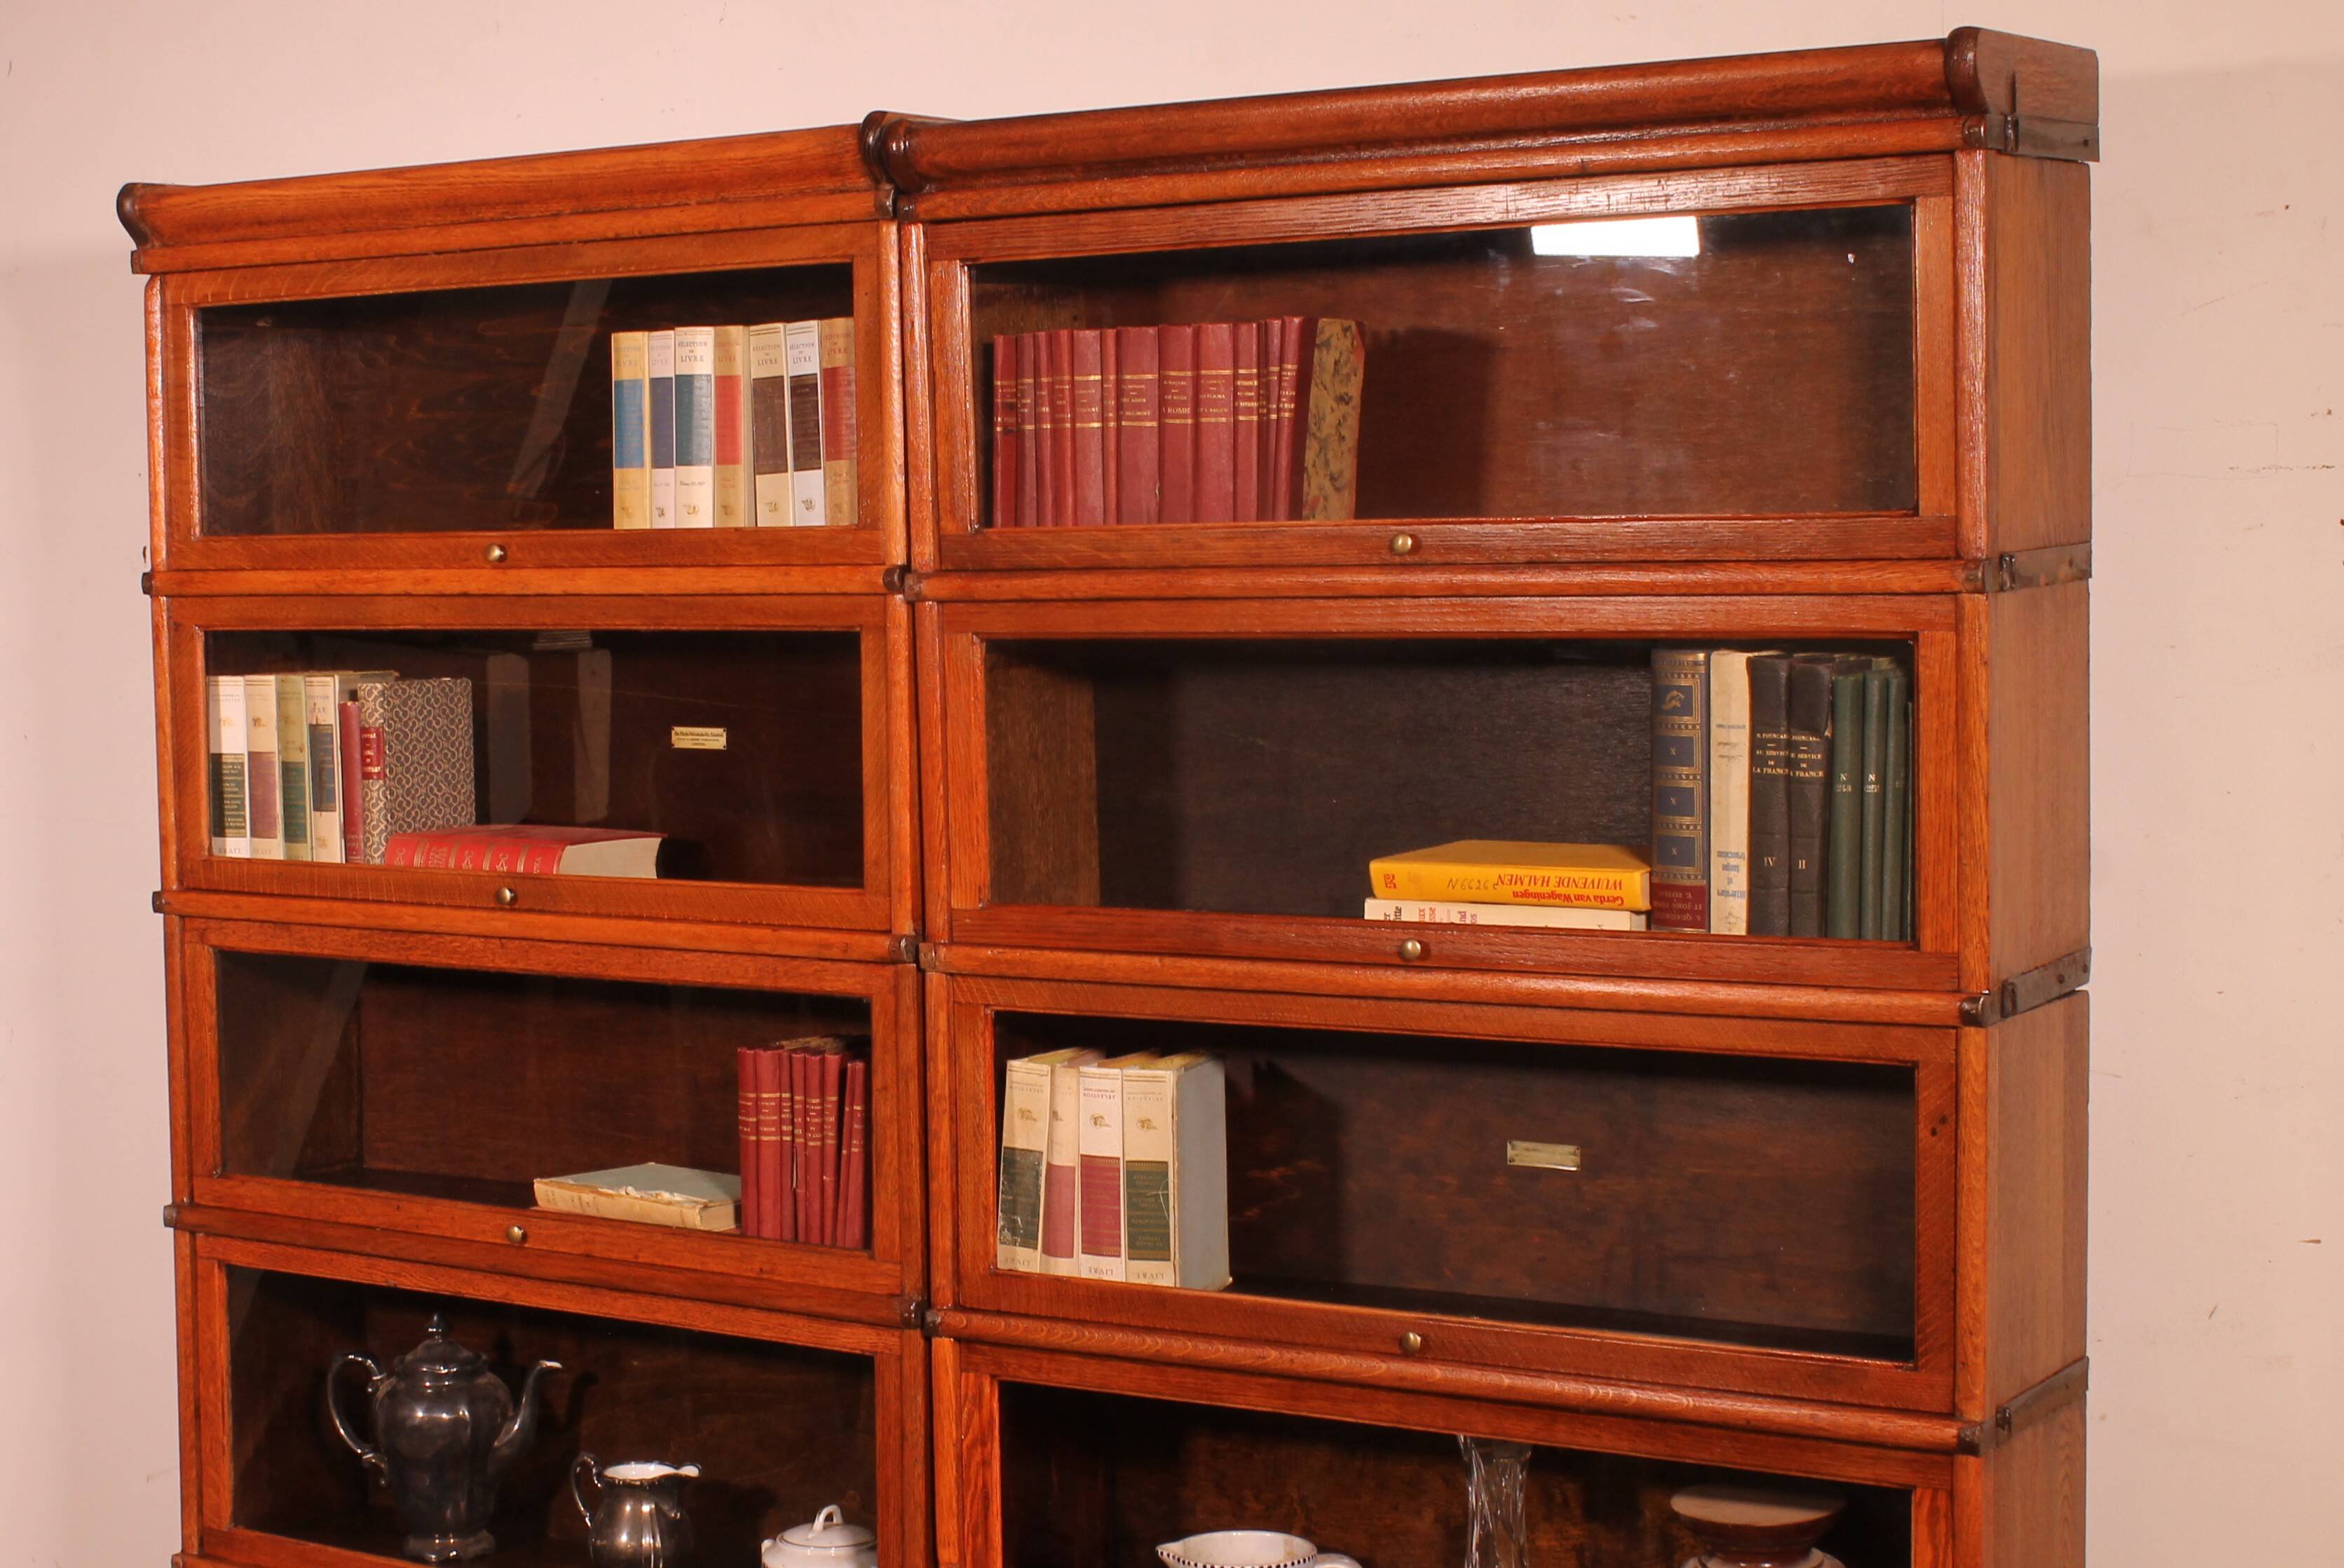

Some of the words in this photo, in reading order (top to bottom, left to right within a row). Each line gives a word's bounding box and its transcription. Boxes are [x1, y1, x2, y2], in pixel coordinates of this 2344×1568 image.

[681, 355, 704, 363] LIVRE
[1868, 773, 1876, 782] N
[1764, 857, 1776, 867] IV
[1799, 859, 1806, 869] II
[1497, 873, 1551, 887] HALMEN
[1554, 876, 1622, 891] WUIVENDE
[1513, 889, 1573, 904] Wageningen
[1574, 893, 1592, 902] van
[1593, 896, 1624, 906] Gerda
[1088, 1267, 1113, 1276] LIVRE
